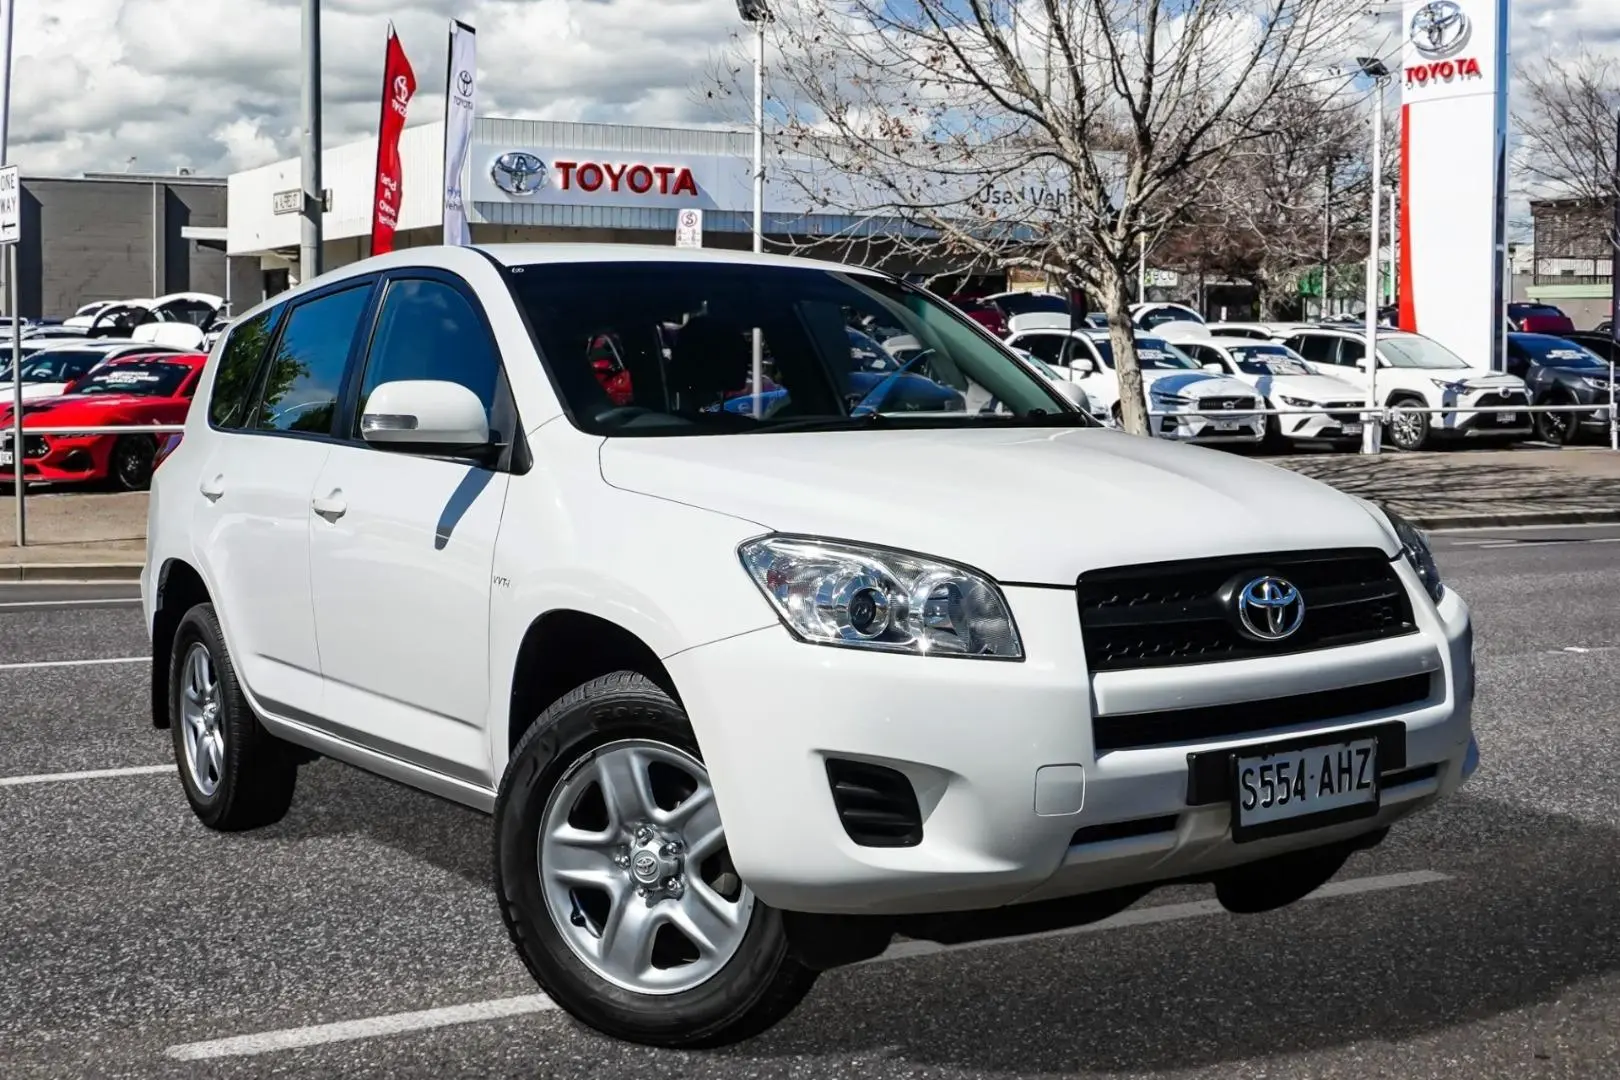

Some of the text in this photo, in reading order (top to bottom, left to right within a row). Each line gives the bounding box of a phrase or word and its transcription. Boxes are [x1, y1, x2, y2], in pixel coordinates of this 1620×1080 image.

[1404, 58, 1481, 83] TOYOTA
[1, 172, 15, 192] ONE
[555, 161, 698, 197] TOYOTA
